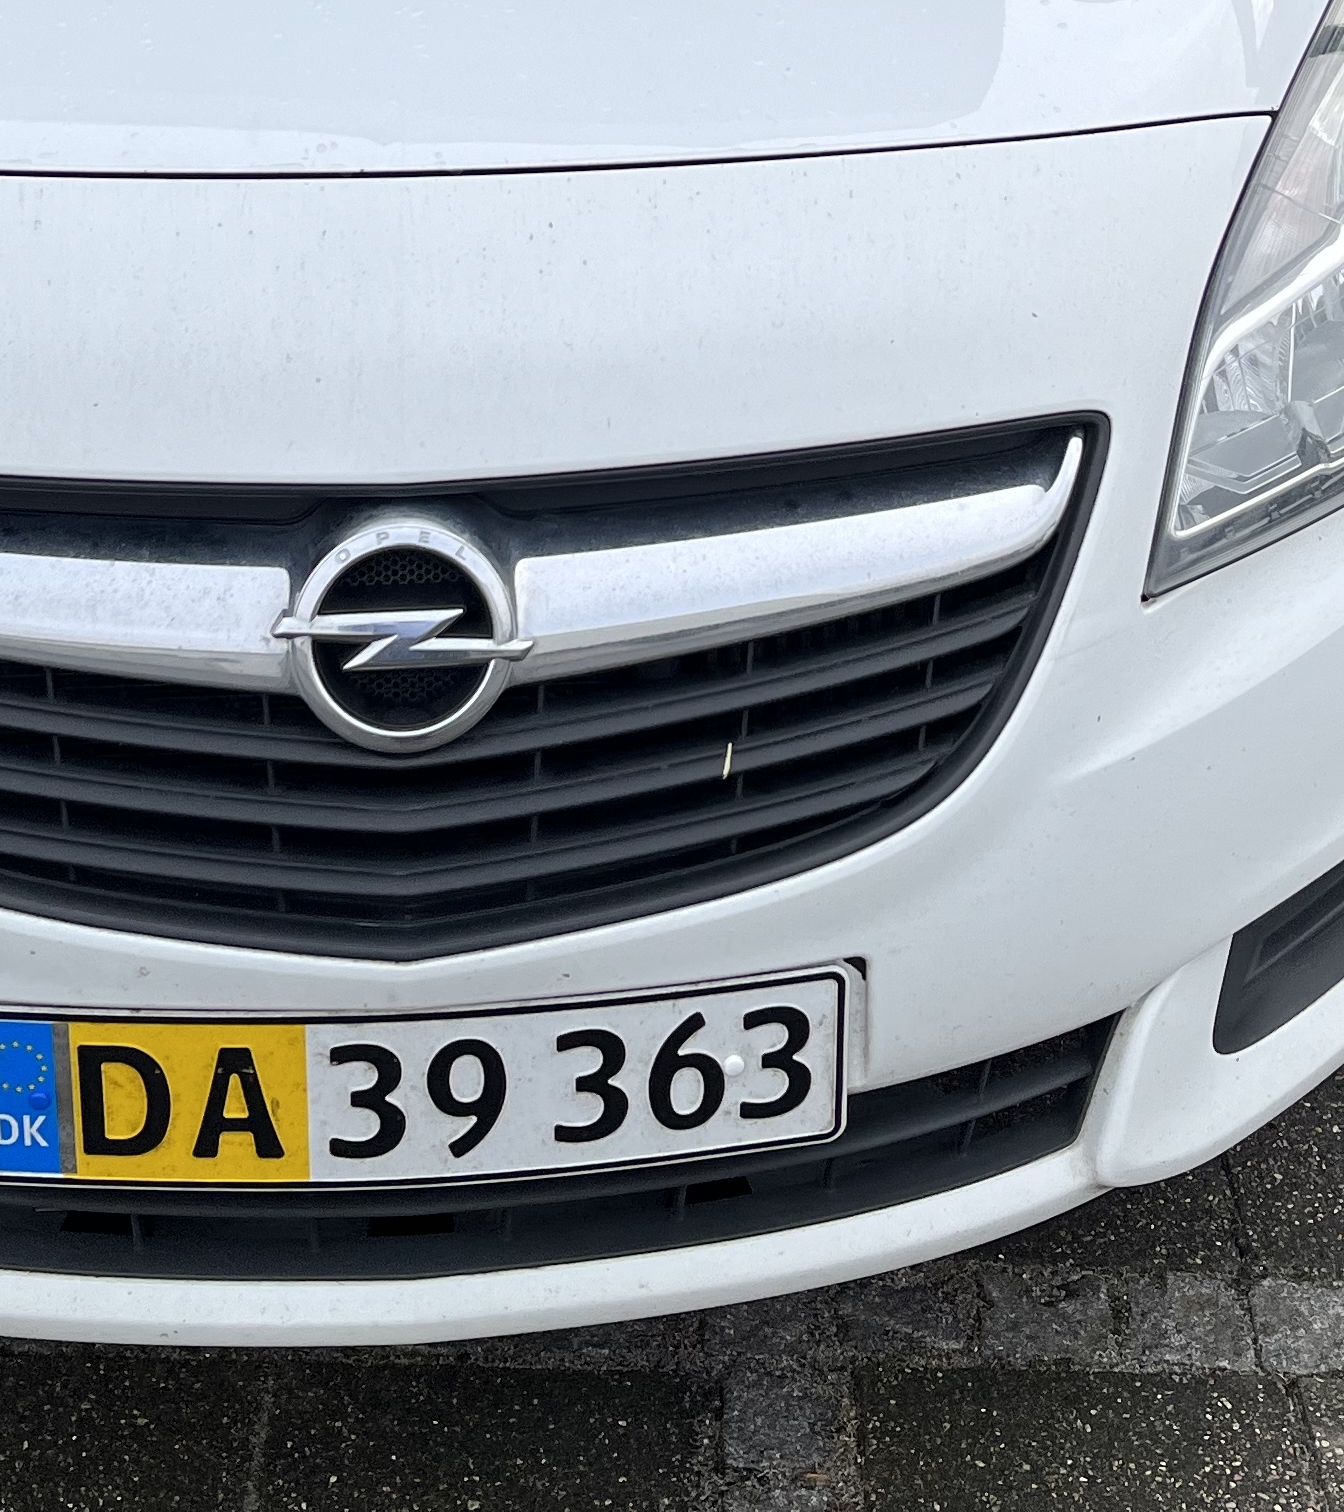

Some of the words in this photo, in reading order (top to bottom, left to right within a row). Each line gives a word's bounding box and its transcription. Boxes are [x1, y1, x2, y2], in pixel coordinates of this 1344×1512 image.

[334, 530, 467, 563] OPEL
[77, 1045, 285, 1158] DA
[328, 1039, 506, 1158] 39
[554, 1006, 813, 1143] 363
